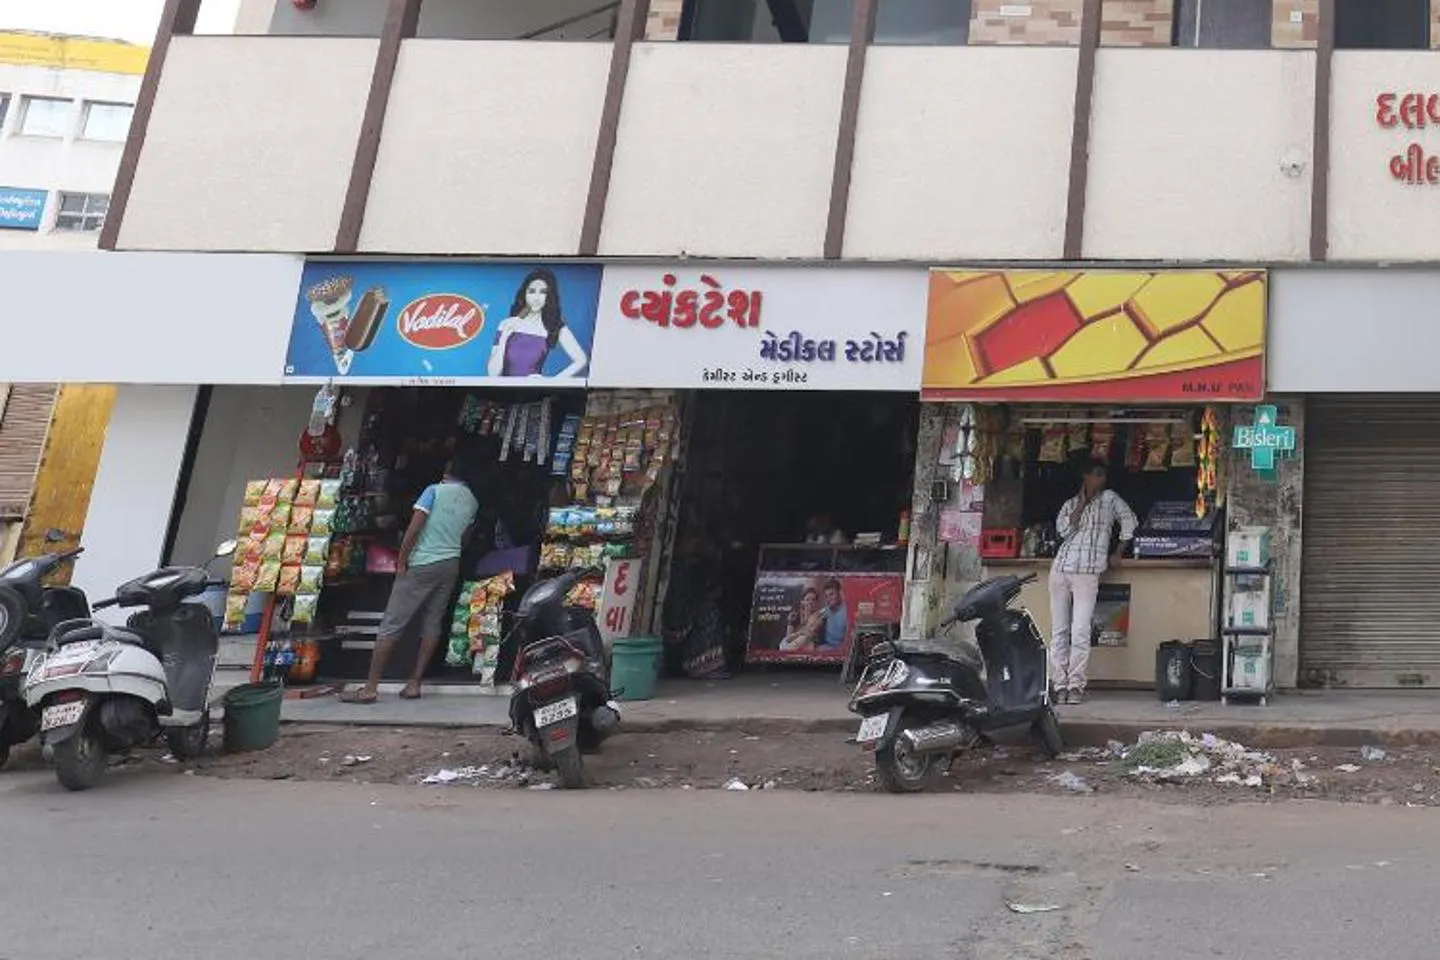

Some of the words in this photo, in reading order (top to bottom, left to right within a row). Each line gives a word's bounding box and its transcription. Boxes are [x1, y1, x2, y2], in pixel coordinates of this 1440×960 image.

[619, 273, 764, 329] વ્યંકટેશ
[403, 301, 477, 339] Vadilal
[760, 329, 836, 363] મેડીકલ
[845, 331, 908, 363] સ્ટોર્સ
[1238, 427, 1290, 447] Bisleri
